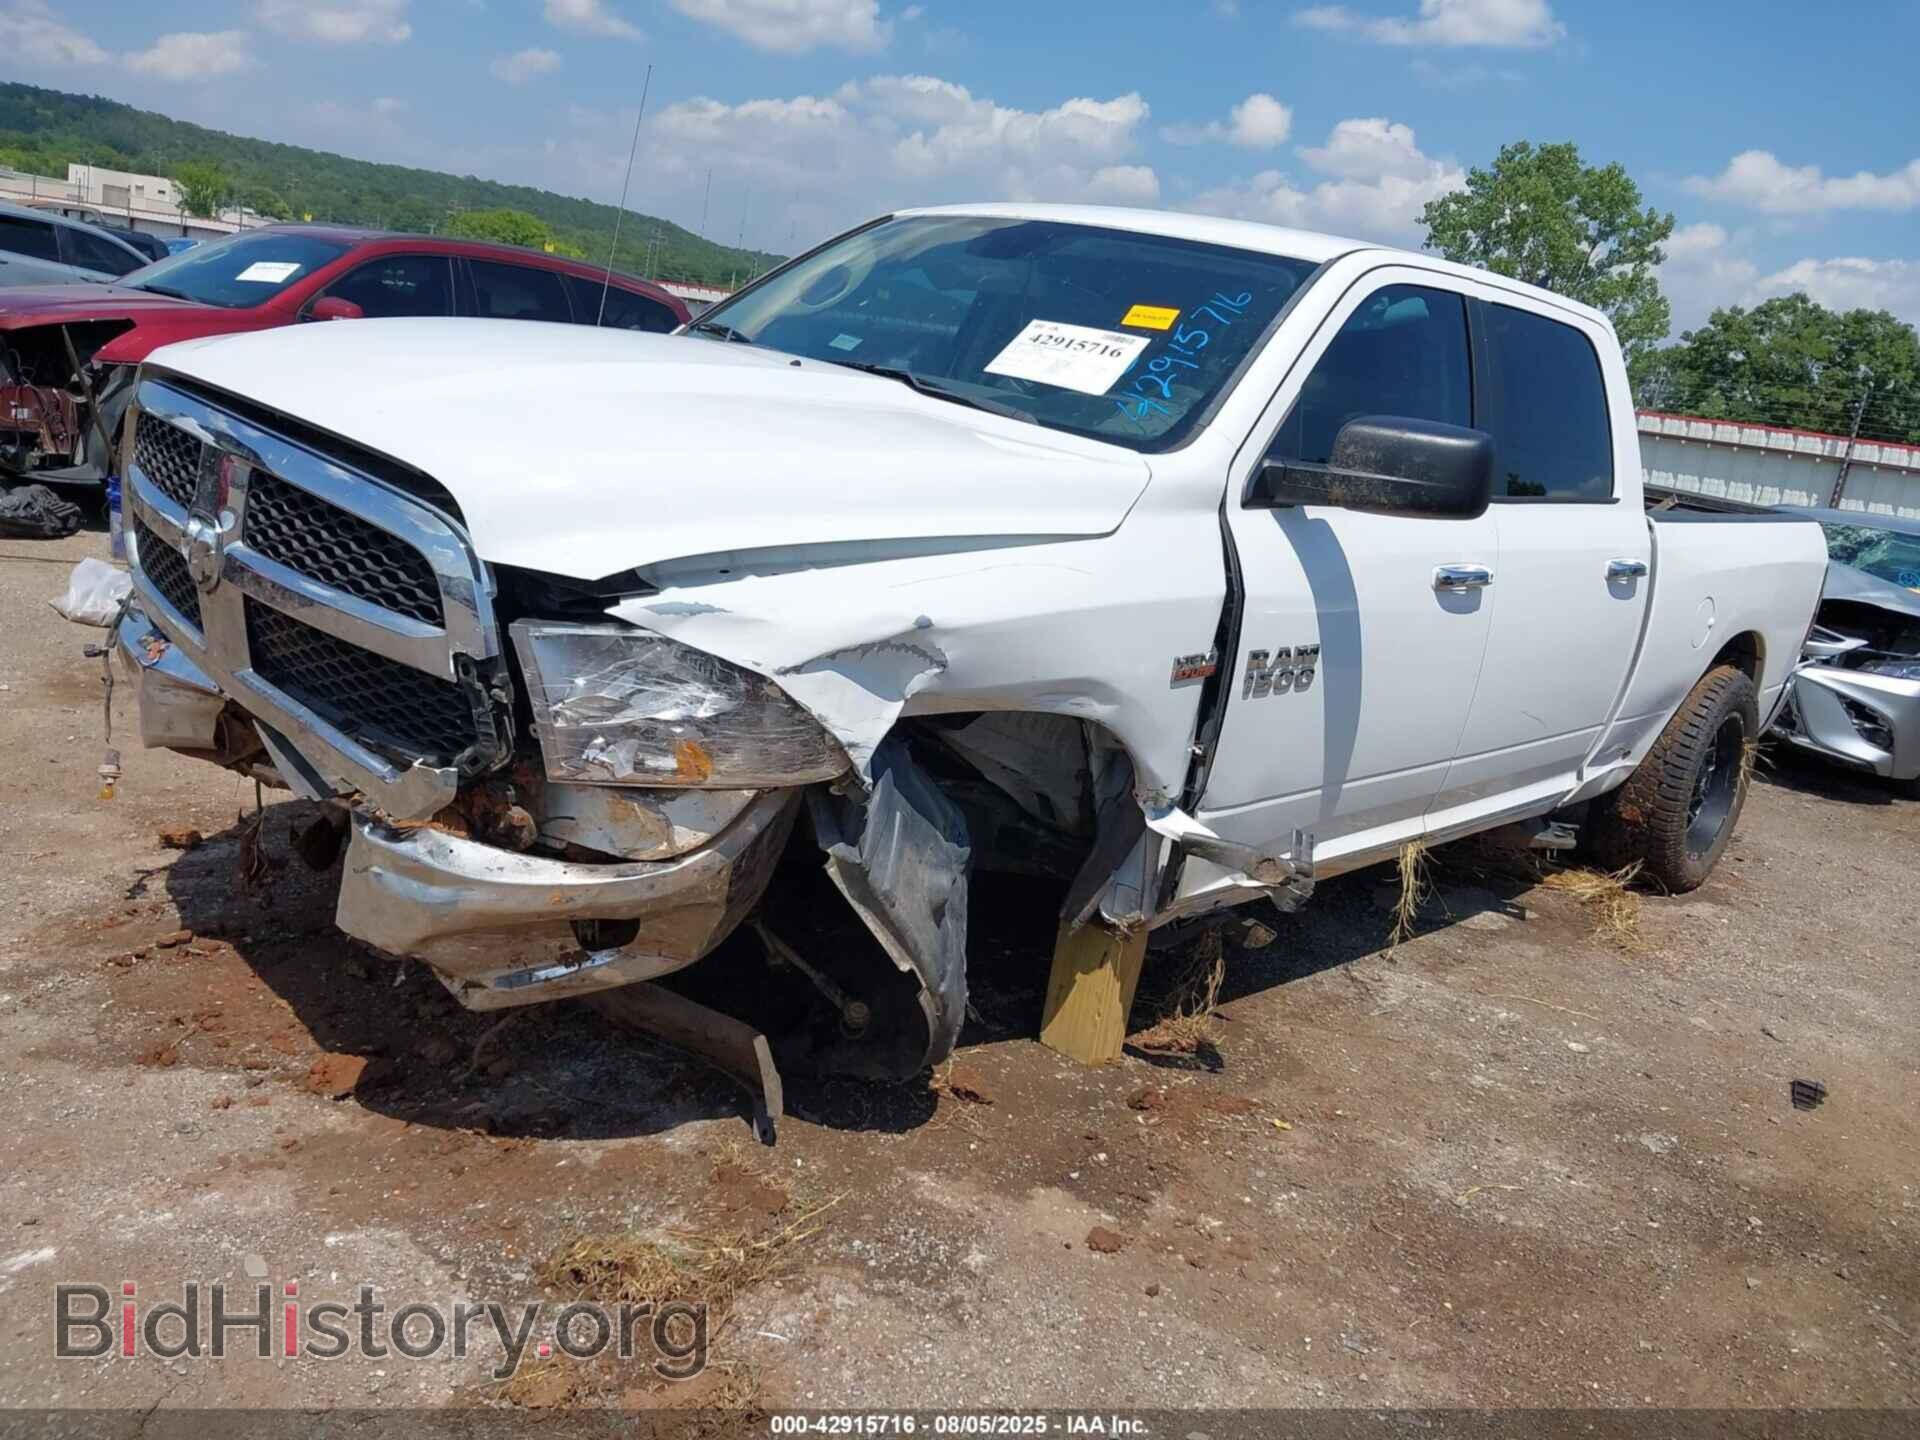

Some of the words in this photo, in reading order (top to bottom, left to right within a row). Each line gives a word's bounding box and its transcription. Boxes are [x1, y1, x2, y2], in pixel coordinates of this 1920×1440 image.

[1028, 334, 1122, 358] 42915716
[1247, 644, 1320, 671] RAM
[1242, 669, 1316, 700] 1500
